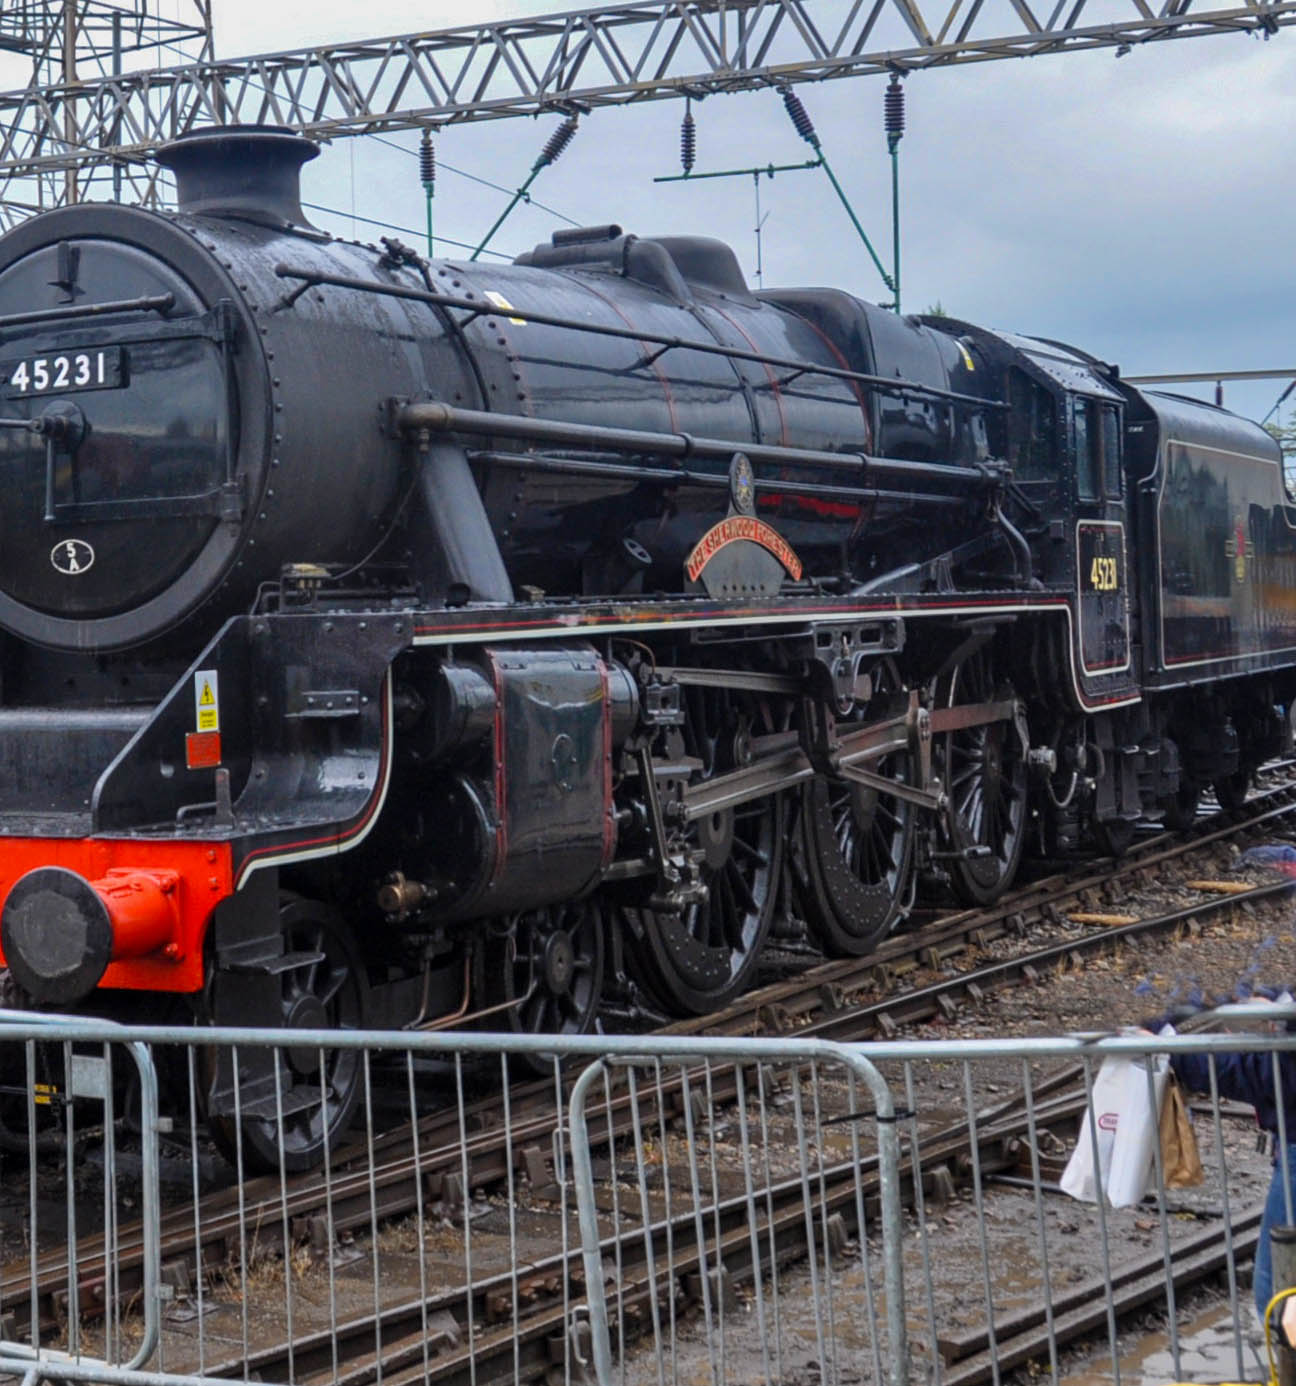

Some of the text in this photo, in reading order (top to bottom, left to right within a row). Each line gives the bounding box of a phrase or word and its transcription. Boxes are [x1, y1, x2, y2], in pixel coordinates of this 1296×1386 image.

[11, 352, 105, 392] 45231
[65, 542, 77, 558] 5
[69, 559, 80, 572] A
[1090, 556, 1118, 591] 45231
